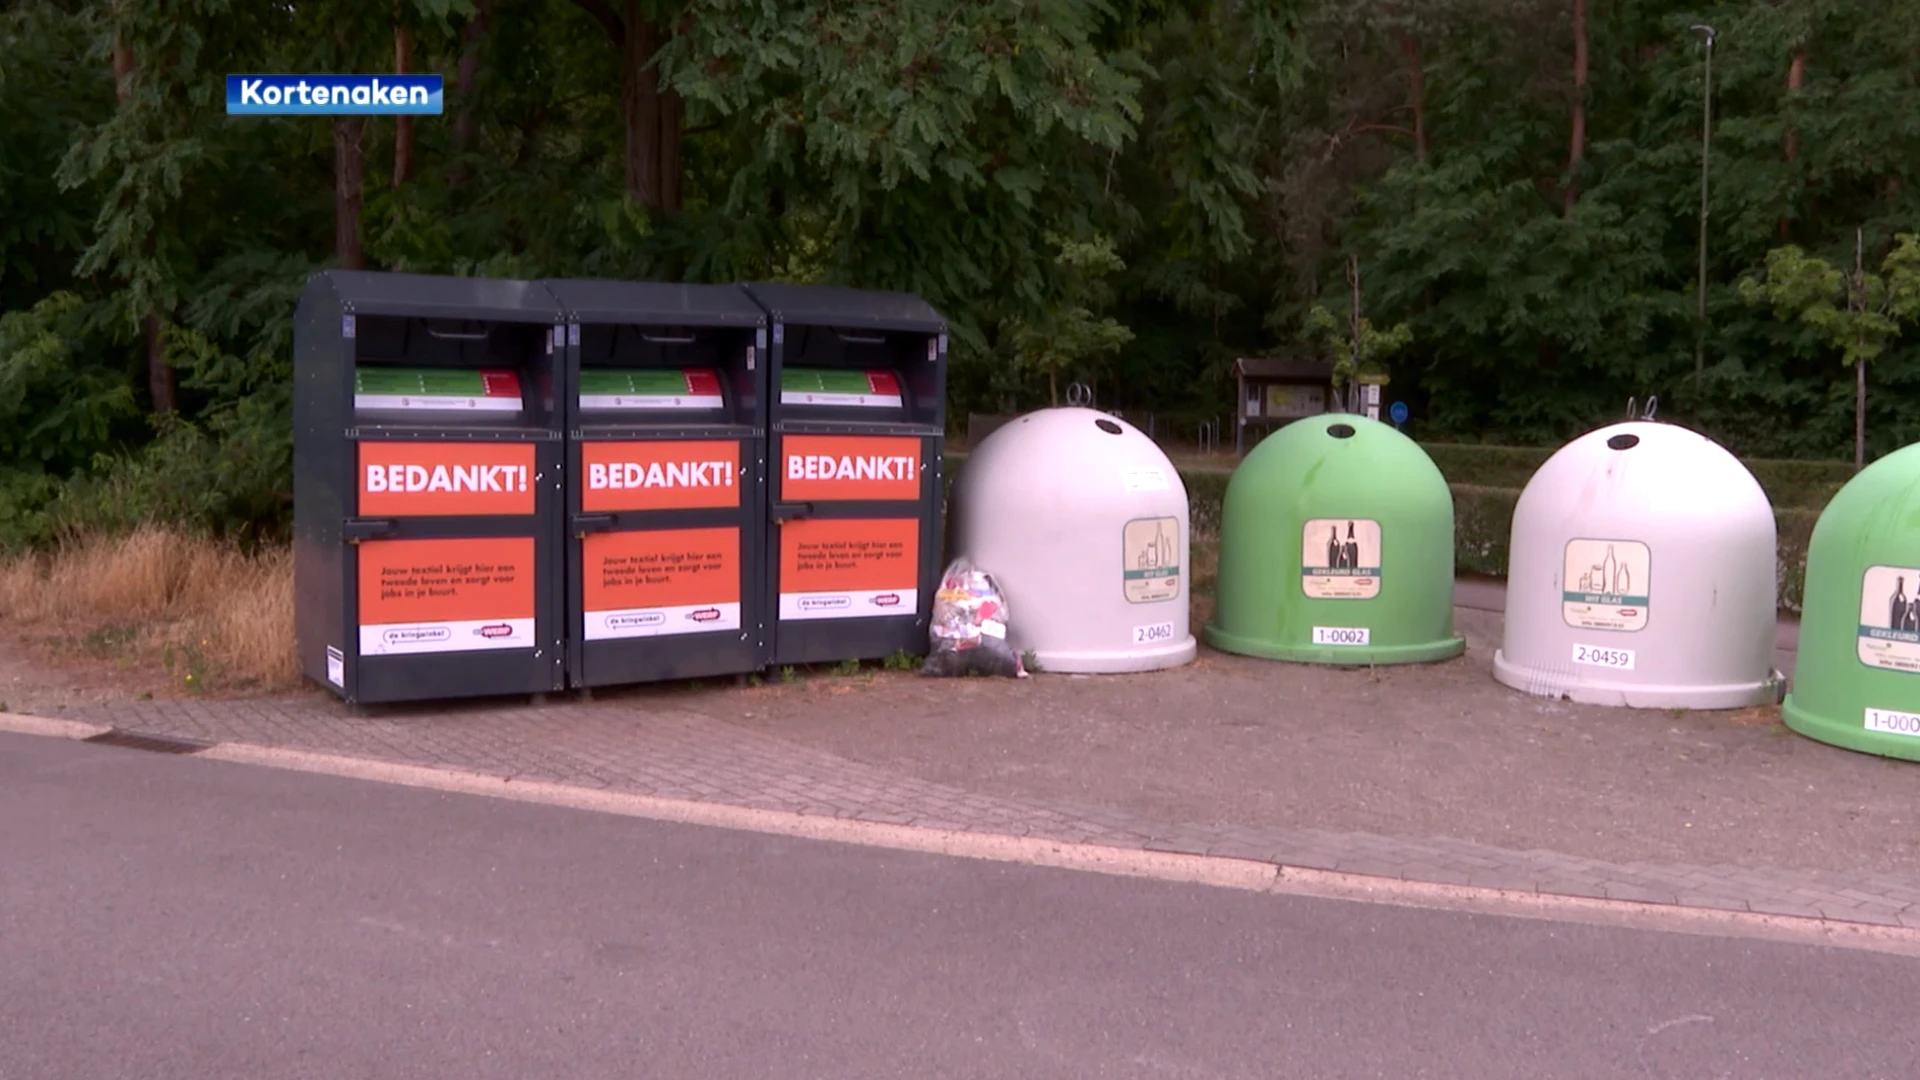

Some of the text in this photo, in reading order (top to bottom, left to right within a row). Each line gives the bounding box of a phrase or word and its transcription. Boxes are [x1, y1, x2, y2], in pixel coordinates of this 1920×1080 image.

[788, 455, 914, 480] BEDANKT!
[367, 464, 527, 492] BEDANKT!
[589, 461, 732, 489] BEDANKT!
[604, 556, 628, 565] Jouw
[630, 555, 658, 564] textiel
[660, 554, 684, 564] krijgt
[687, 552, 704, 560] hier
[381, 564, 515, 575] Jouw textiel krijgt hier een
[603, 566, 636, 575] tweede
[638, 564, 662, 573] leven
[678, 564, 700, 573] zorgt
[1352, 568, 1372, 576] GLAS
[381, 577, 417, 586] tweede
[420, 576, 447, 585] leven
[465, 576, 490, 585] zorgt
[603, 575, 672, 588] jobs in je buurt.
[380, 588, 458, 600] jobs in je buurt.
[1138, 624, 1172, 642] 2-0462
[1320, 629, 1364, 643] 1-0002
[1870, 629, 1919, 642] GEKLEURD
[1578, 646, 1629, 666] 2-0459
